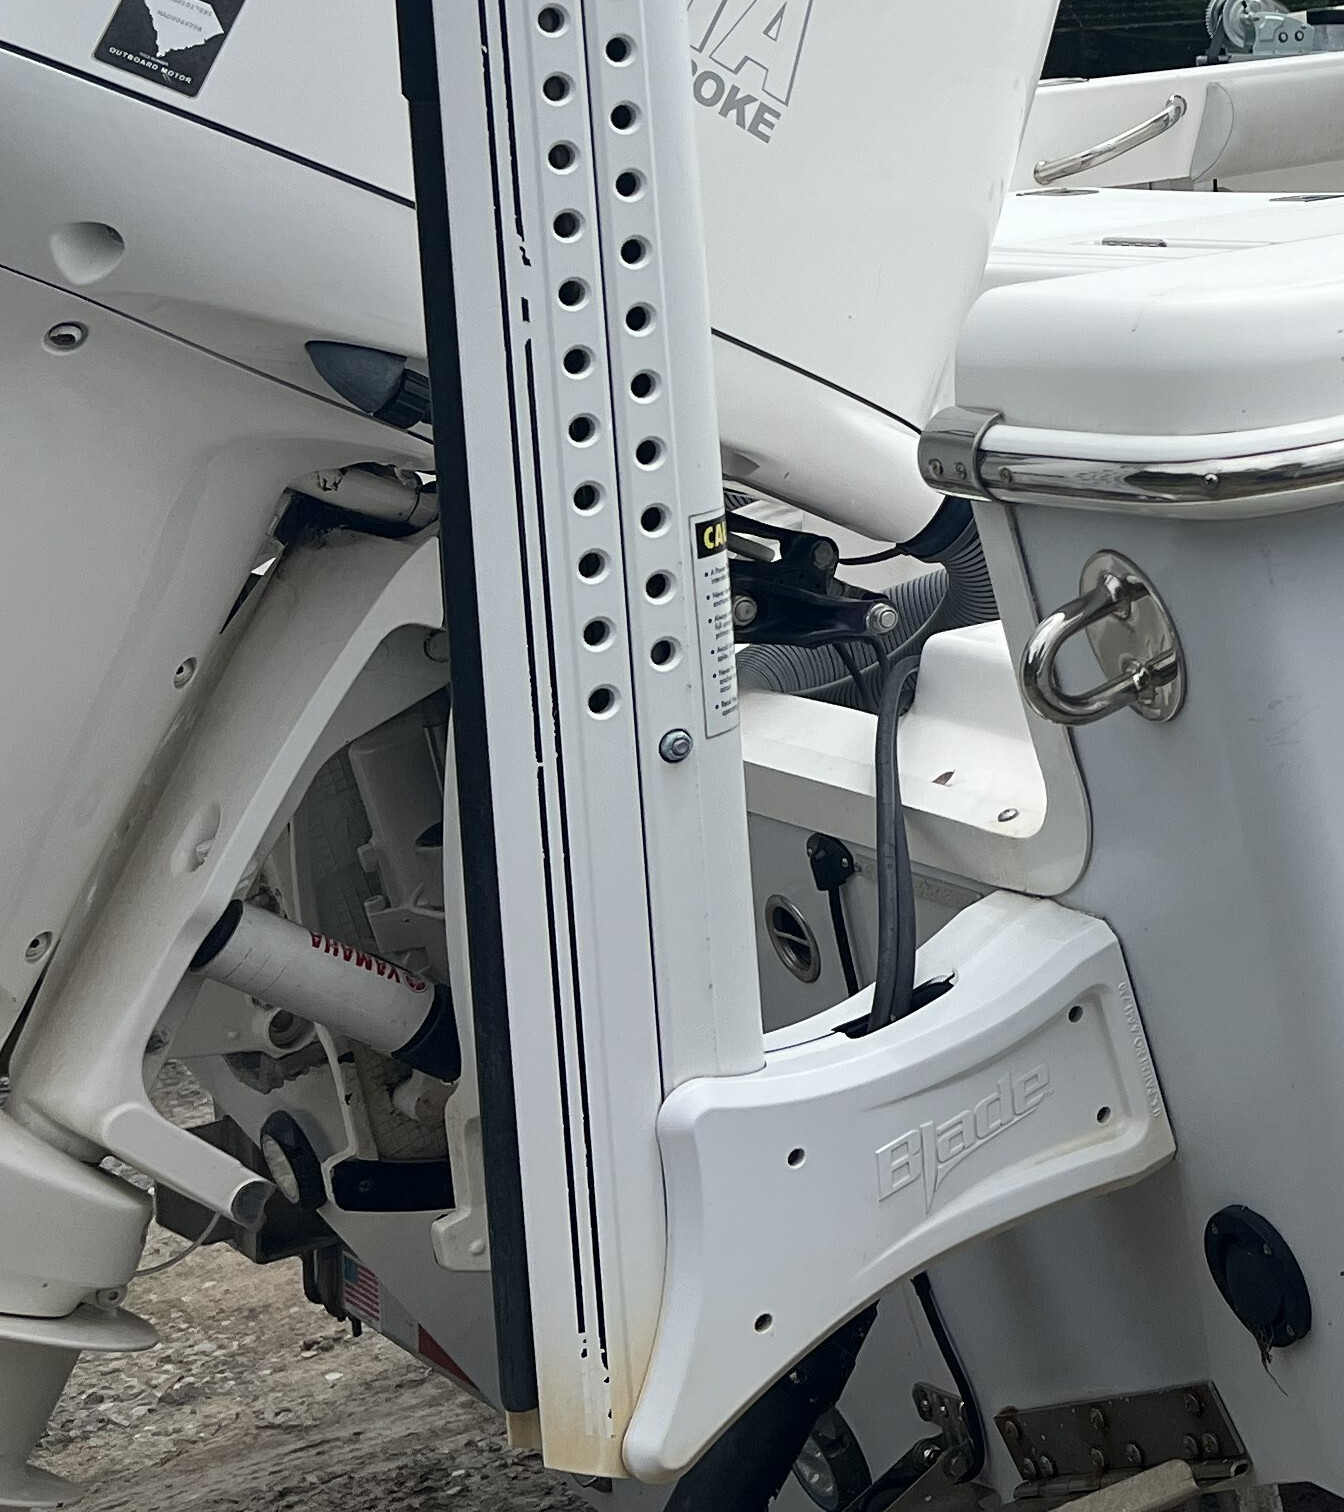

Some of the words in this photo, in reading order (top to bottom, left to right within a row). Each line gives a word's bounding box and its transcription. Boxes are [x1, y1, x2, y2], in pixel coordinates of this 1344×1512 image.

[108, 46, 159, 71] OUTBOARD
[160, 67, 193, 85] MOTOR
[310, 931, 401, 984] YAMAHA
[874, 1062, 1054, 1215] Blade
